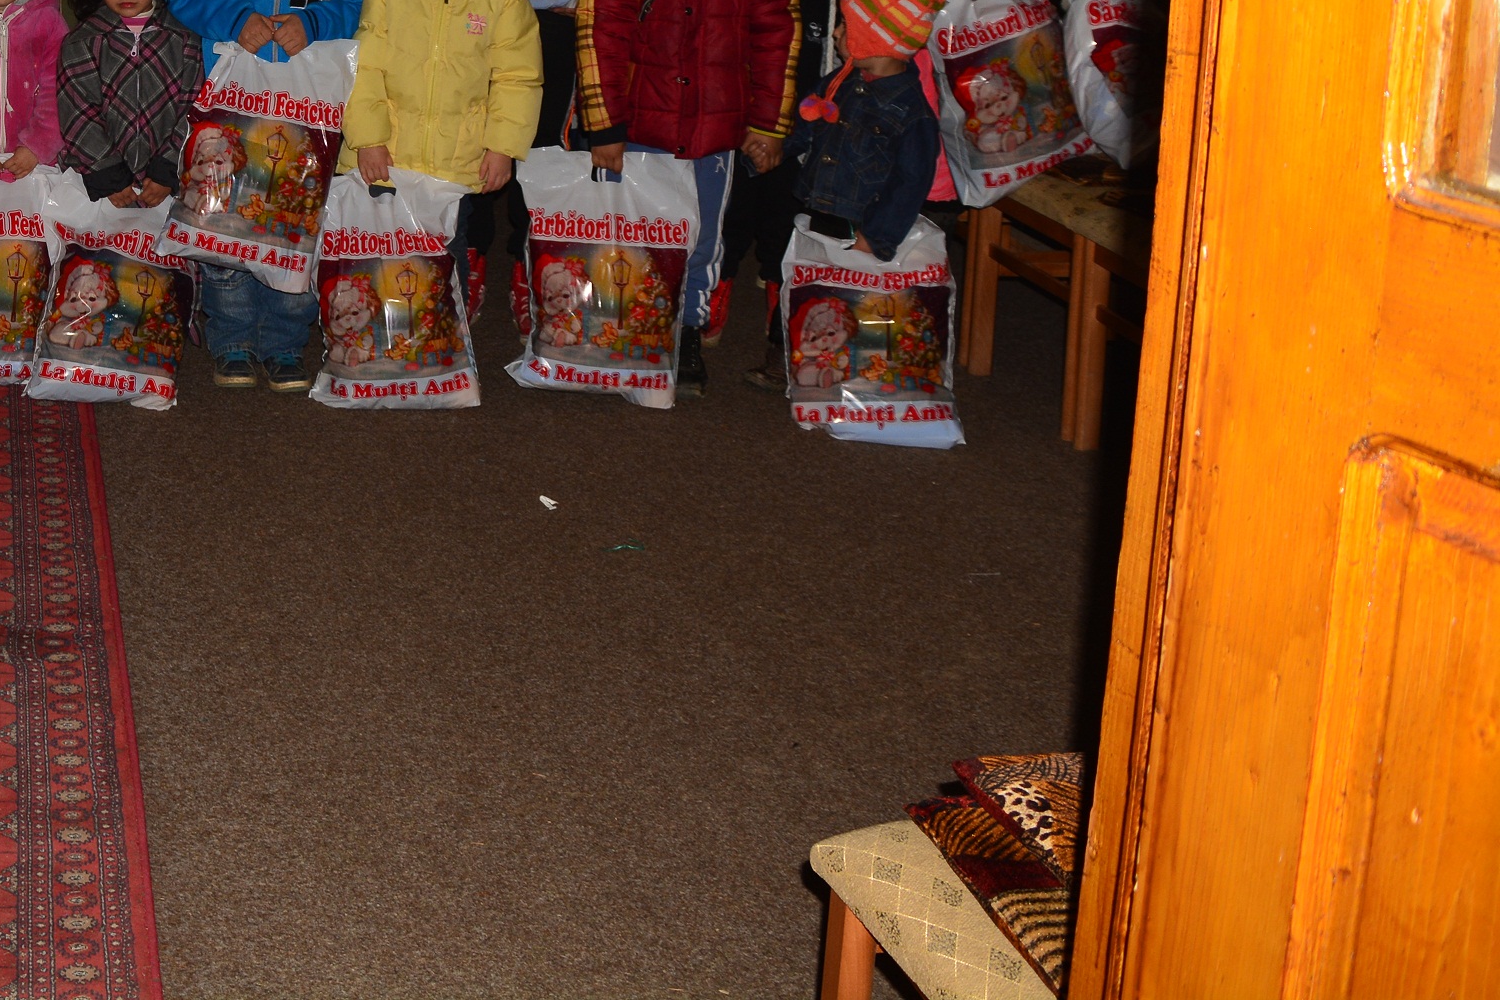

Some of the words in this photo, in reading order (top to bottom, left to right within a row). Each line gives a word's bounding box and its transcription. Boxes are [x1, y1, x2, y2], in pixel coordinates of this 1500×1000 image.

[614, 215, 689, 246] Fericite!
[166, 222, 191, 246] La
[260, 248, 308, 274] Ani!
[39, 361, 67, 382] La
[330, 377, 349, 399] La
[423, 372, 471, 396] Ani!
[528, 359, 550, 379] La
[622, 372, 669, 390] Ani!
[794, 403, 822, 423] La
